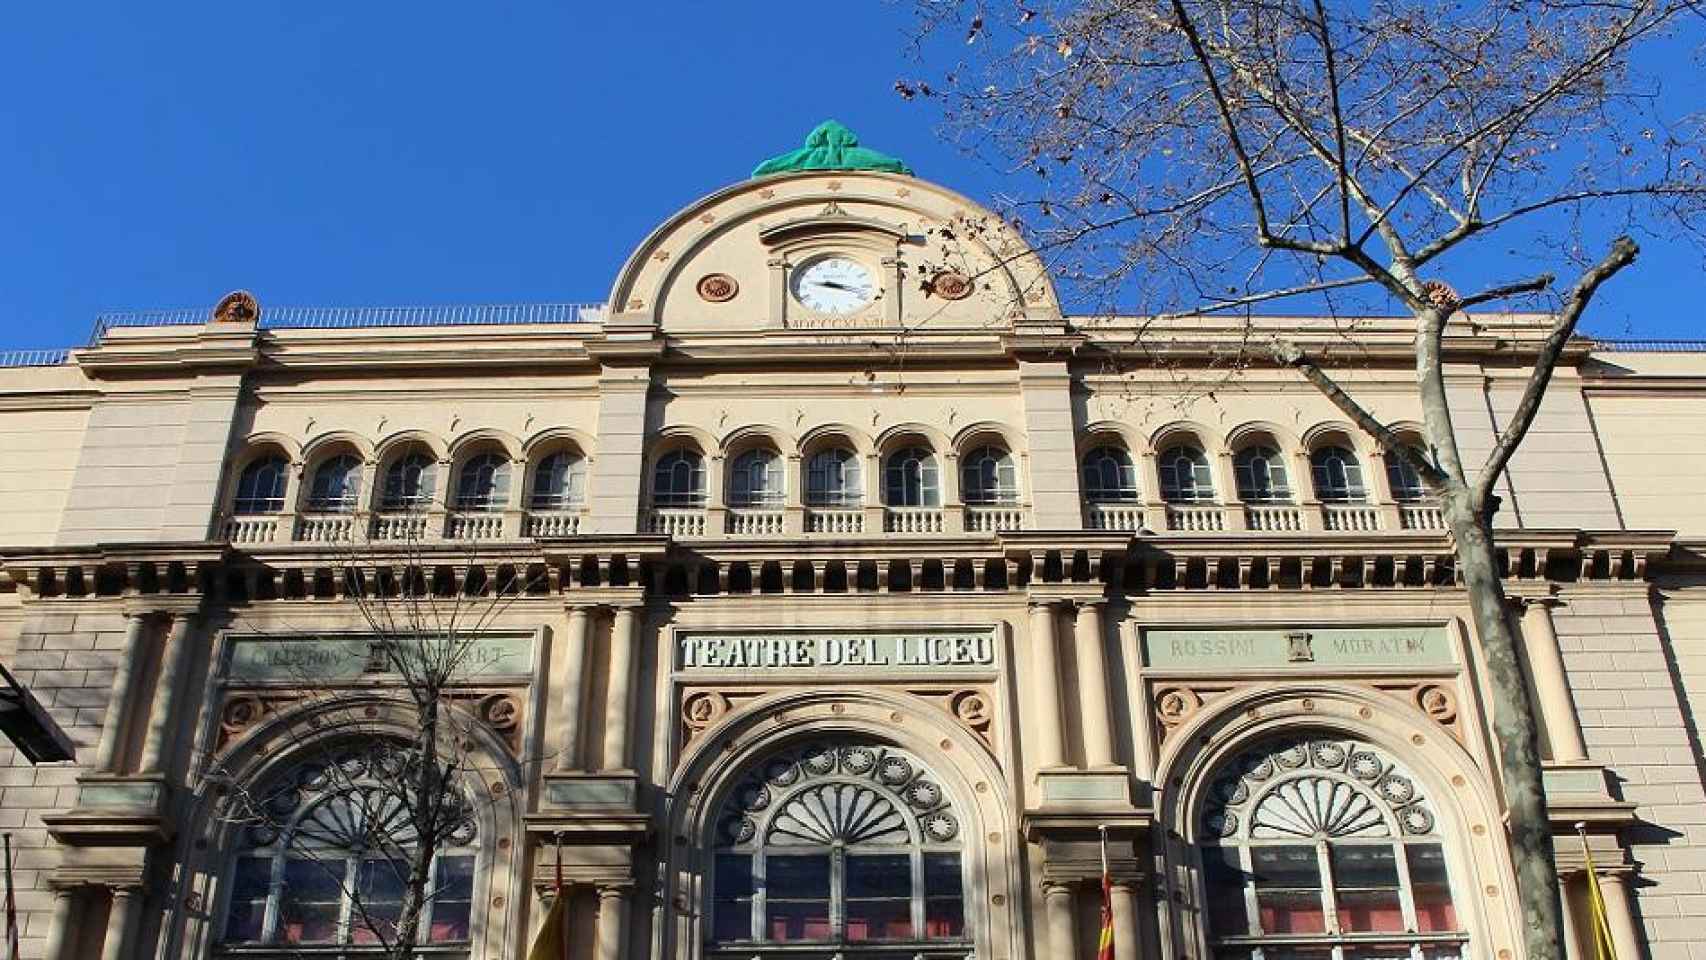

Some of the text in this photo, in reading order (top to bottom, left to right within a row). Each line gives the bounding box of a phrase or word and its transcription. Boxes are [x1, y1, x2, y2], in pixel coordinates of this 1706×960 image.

[680, 637, 993, 667] TEATRE DEL LICEU
[1171, 638, 1256, 656] ROSSINI
